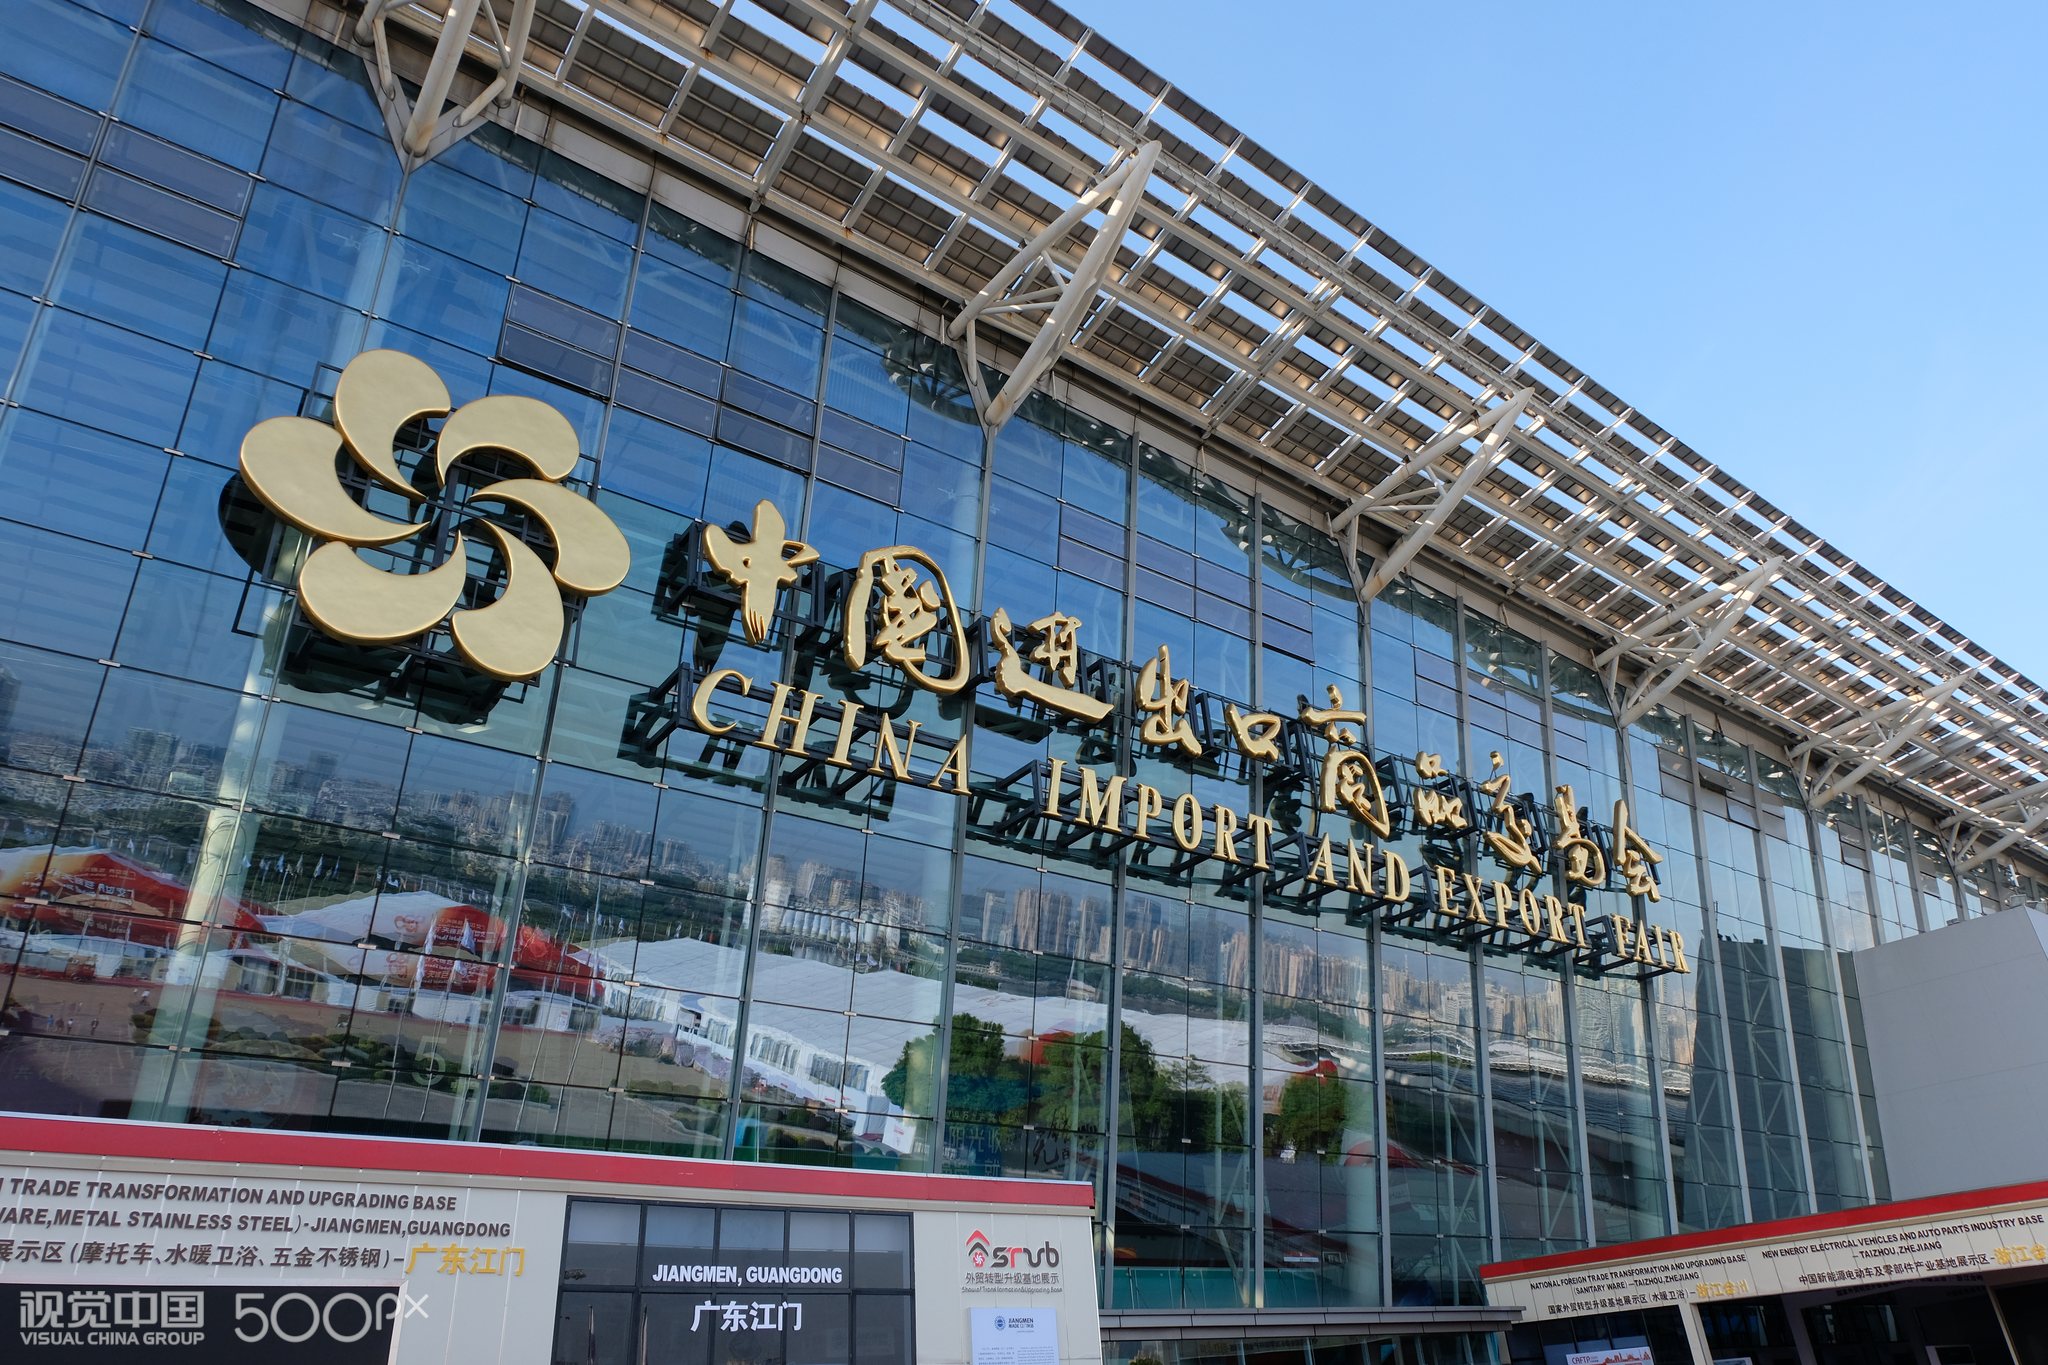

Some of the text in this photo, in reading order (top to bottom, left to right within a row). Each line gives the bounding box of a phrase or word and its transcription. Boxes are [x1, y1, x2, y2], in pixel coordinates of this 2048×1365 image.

[692, 669, 1692, 974] CHINA IMPORT AND EXPORT FAIR
[10, 1178, 80, 1197] TRADE
[86, 1181, 264, 1205] TRANSFORMATION
[266, 1189, 305, 1206] AND
[308, 1191, 409, 1210] UPGRADING
[413, 1195, 457, 1211] BASE
[127, 1211, 232, 1231] STAINLESS
[1761, 1214, 2045, 1259] NEW ENERGY ELECTRICAL VEHICLES AND AUTO PARTS INDUSTRY BASE
[652, 1264, 843, 1287] JIANGMEN, GUANGDONG
[1530, 1253, 1747, 1290] NATIONAL FOREIGN TRADE TRANSFORMATION AND UPGRADING BASE
[690, 1300, 803, 1333] 广东江门
